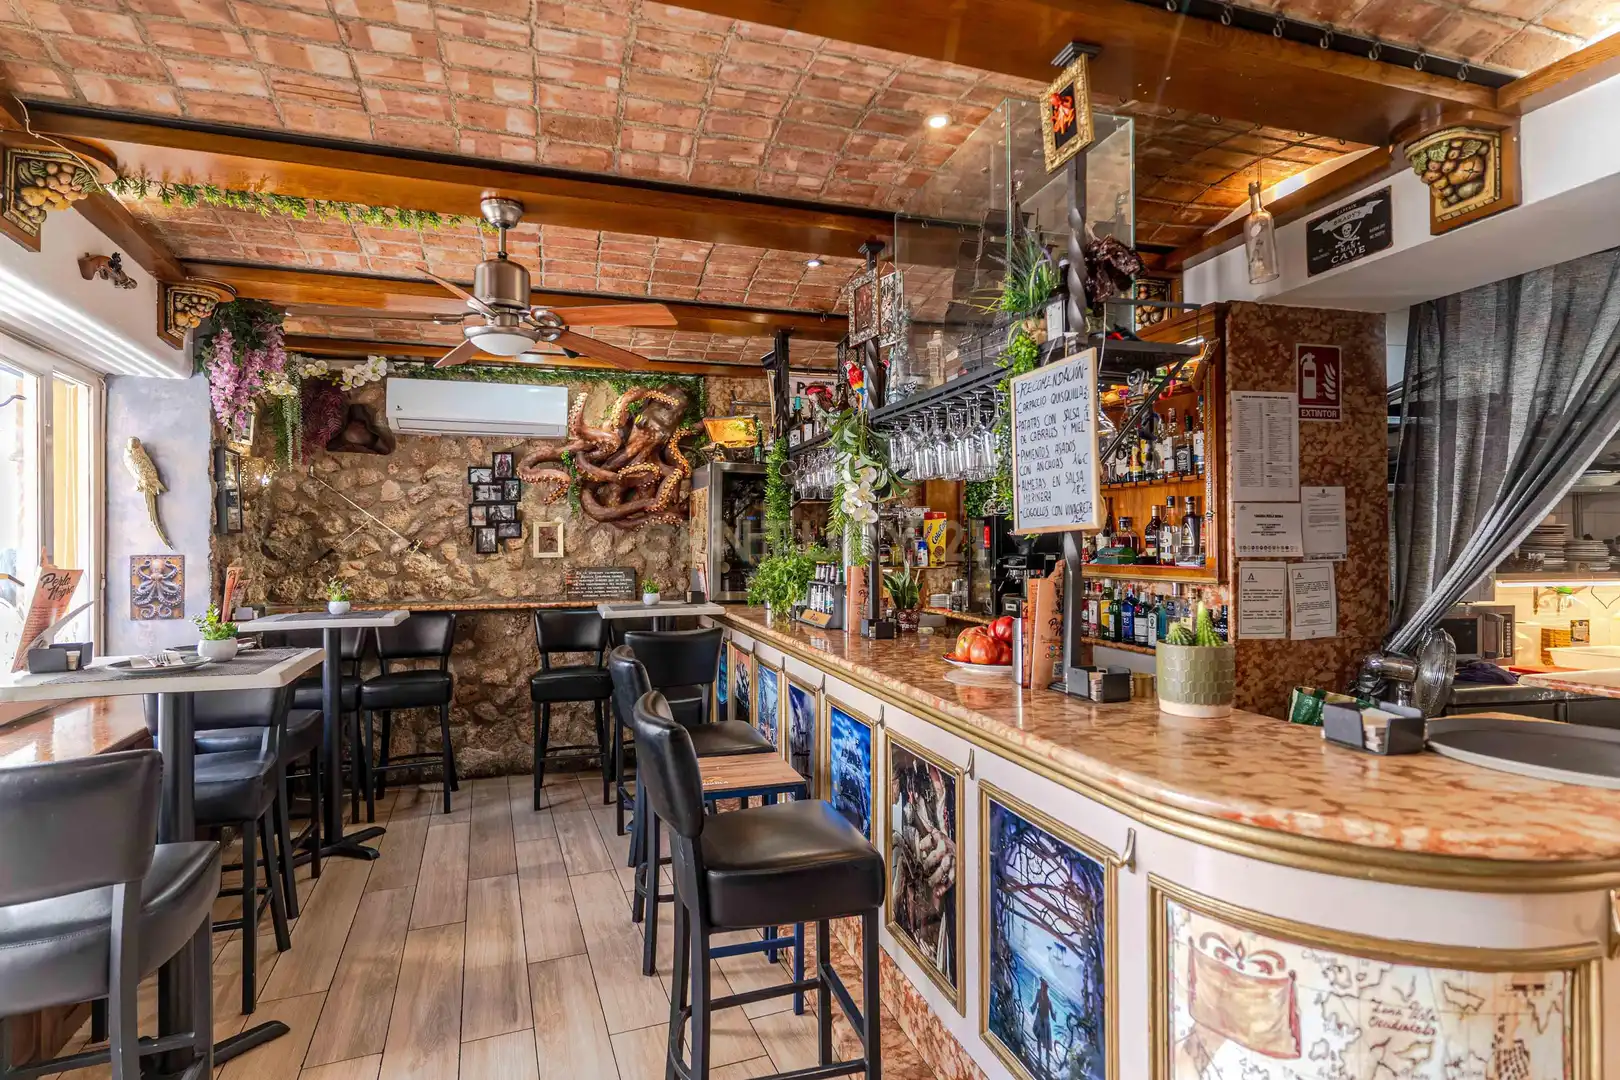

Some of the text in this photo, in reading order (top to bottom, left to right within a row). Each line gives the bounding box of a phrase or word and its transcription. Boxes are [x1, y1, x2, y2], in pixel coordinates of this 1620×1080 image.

[1331, 245, 1366, 264] CAVE
[1340, 242, 1356, 253] MAN
[1019, 416, 1040, 432] PATATAS
[1043, 413, 1056, 427] CON
[1063, 407, 1080, 422] SALSA
[1301, 409, 1337, 418] EXTINTOR
[1020, 434, 1027, 445] DE
[1062, 424, 1067, 437] Y
[1071, 421, 1085, 433] MIEL
[1021, 440, 1076, 461] PIMIENTOS ASADOS
[1019, 464, 1031, 476] CON
[1022, 470, 1084, 492] ALMEJAS EN SALSA
[1023, 506, 1050, 519] COGOLLOS
[1052, 504, 1063, 517] CON
[40, 572, 72, 589] Perla
[47, 584, 76, 600] Negra
